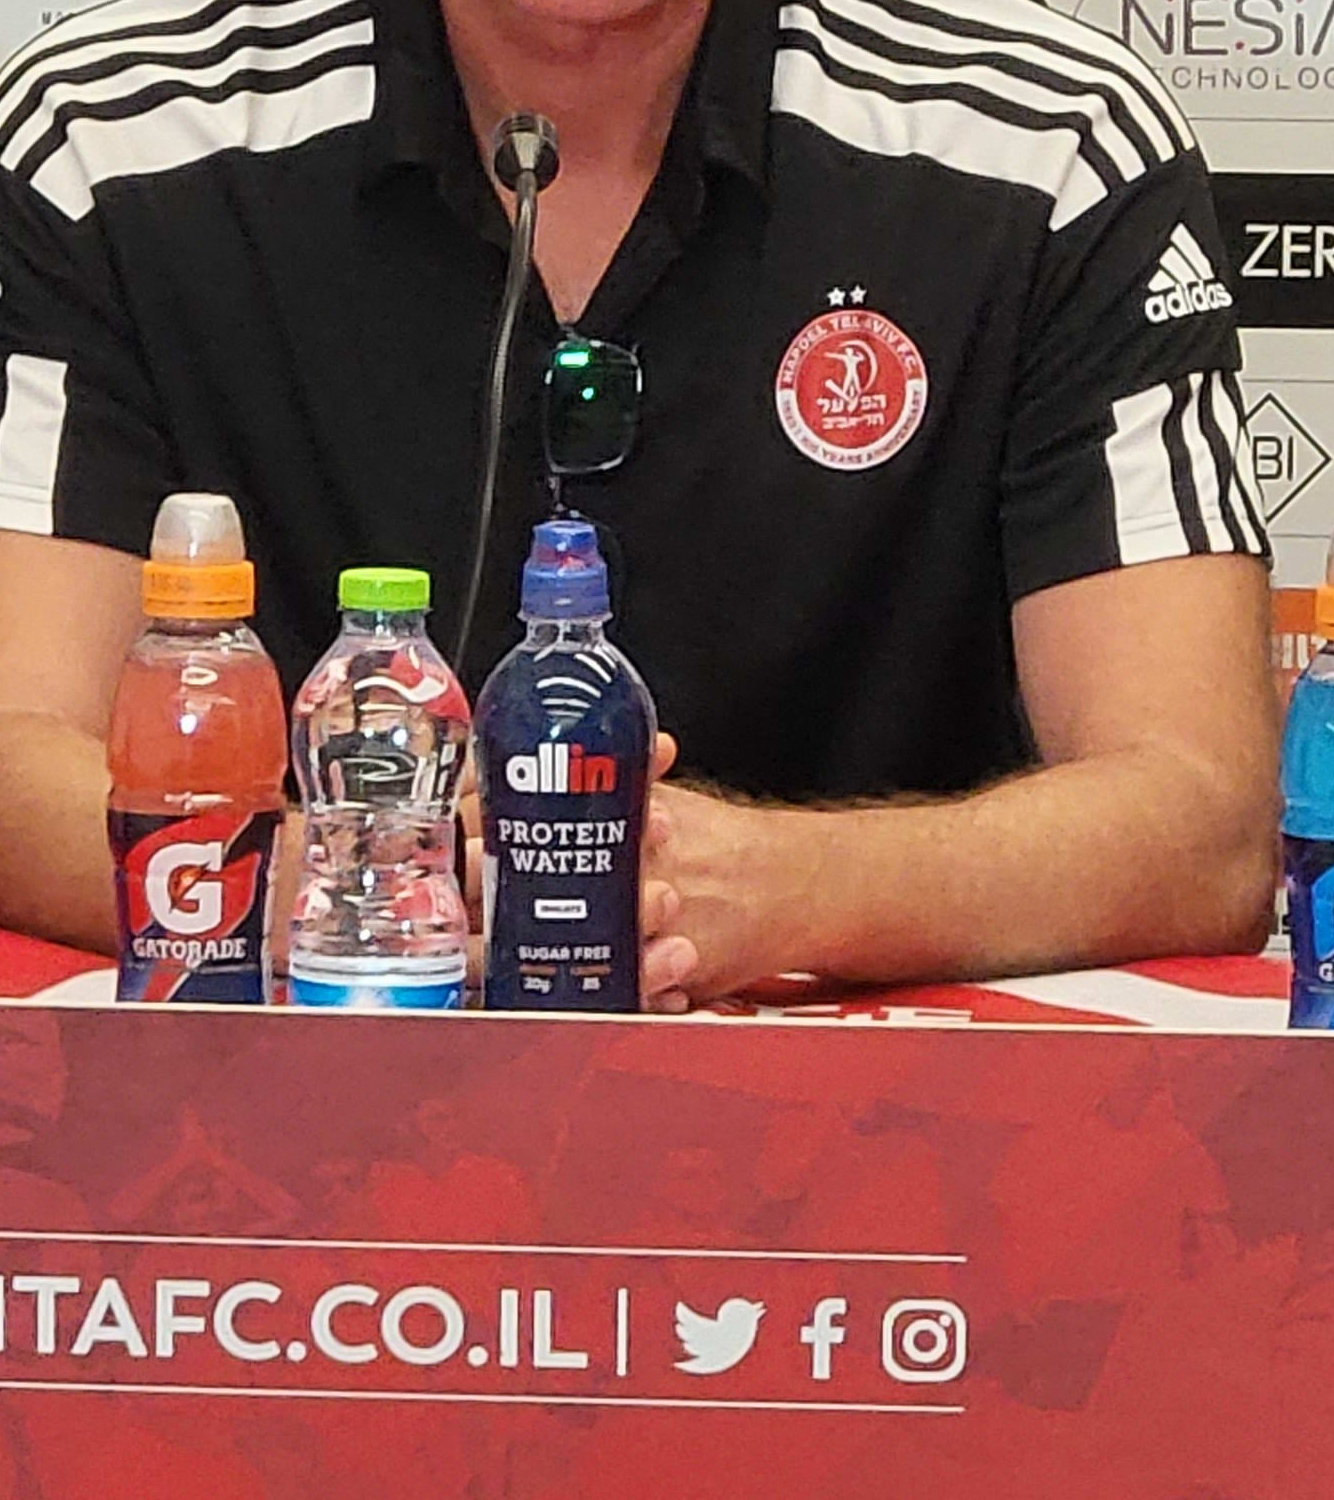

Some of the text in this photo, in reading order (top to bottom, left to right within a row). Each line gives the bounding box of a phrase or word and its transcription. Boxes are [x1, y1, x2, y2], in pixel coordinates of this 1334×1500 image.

[1145, 278, 1232, 322] adidas
[506, 742, 616, 793] allin
[498, 819, 626, 845] PROTEIN
[510, 848, 612, 873] WATER
[131, 934, 249, 970] GATORADE
